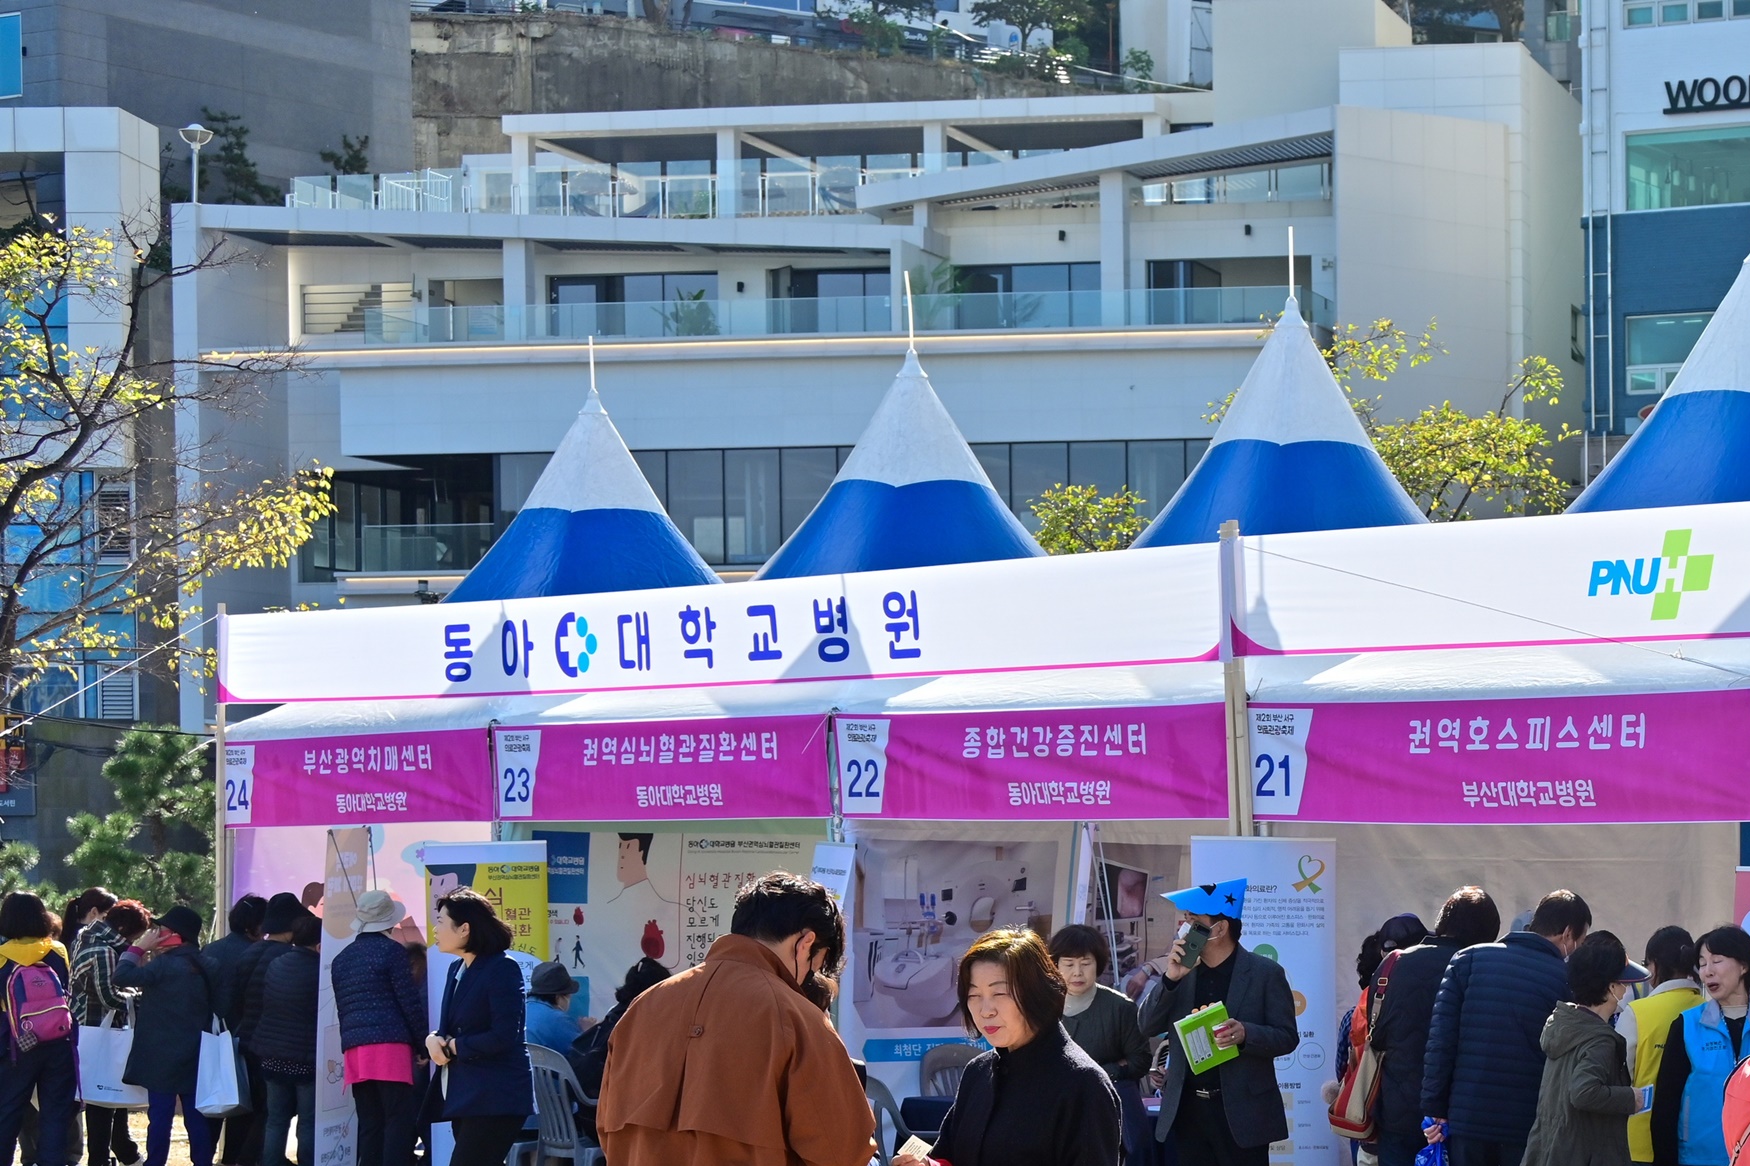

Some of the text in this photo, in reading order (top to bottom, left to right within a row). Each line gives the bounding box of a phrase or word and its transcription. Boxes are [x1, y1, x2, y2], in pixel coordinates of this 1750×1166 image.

[1255, 713, 1295, 723] 제2회 부산 서구
[1257, 724, 1295, 736] 의료관광축제
[962, 722, 1147, 759] 종합건강증진센터
[1408, 712, 1646, 756] 권역호스피스센터
[303, 744, 433, 776] 부산광역치매센터
[583, 731, 778, 766] 권역심뇌혈관질환센터
[503, 767, 530, 803] 23
[846, 759, 881, 798] 22
[1255, 753, 1292, 797] 21
[225, 779, 249, 811] 24
[336, 791, 408, 814] 동아대학교병원
[636, 784, 724, 808] 동아대학교병원
[1007, 780, 1112, 806] 동아대학교병원
[1462, 778, 1597, 808] 부산대학교병원
[504, 908, 532, 921] 혈관
[686, 896, 719, 913] 당신도
[686, 914, 720, 927] 모르게
[893, 1043, 922, 1057] 최첨단
